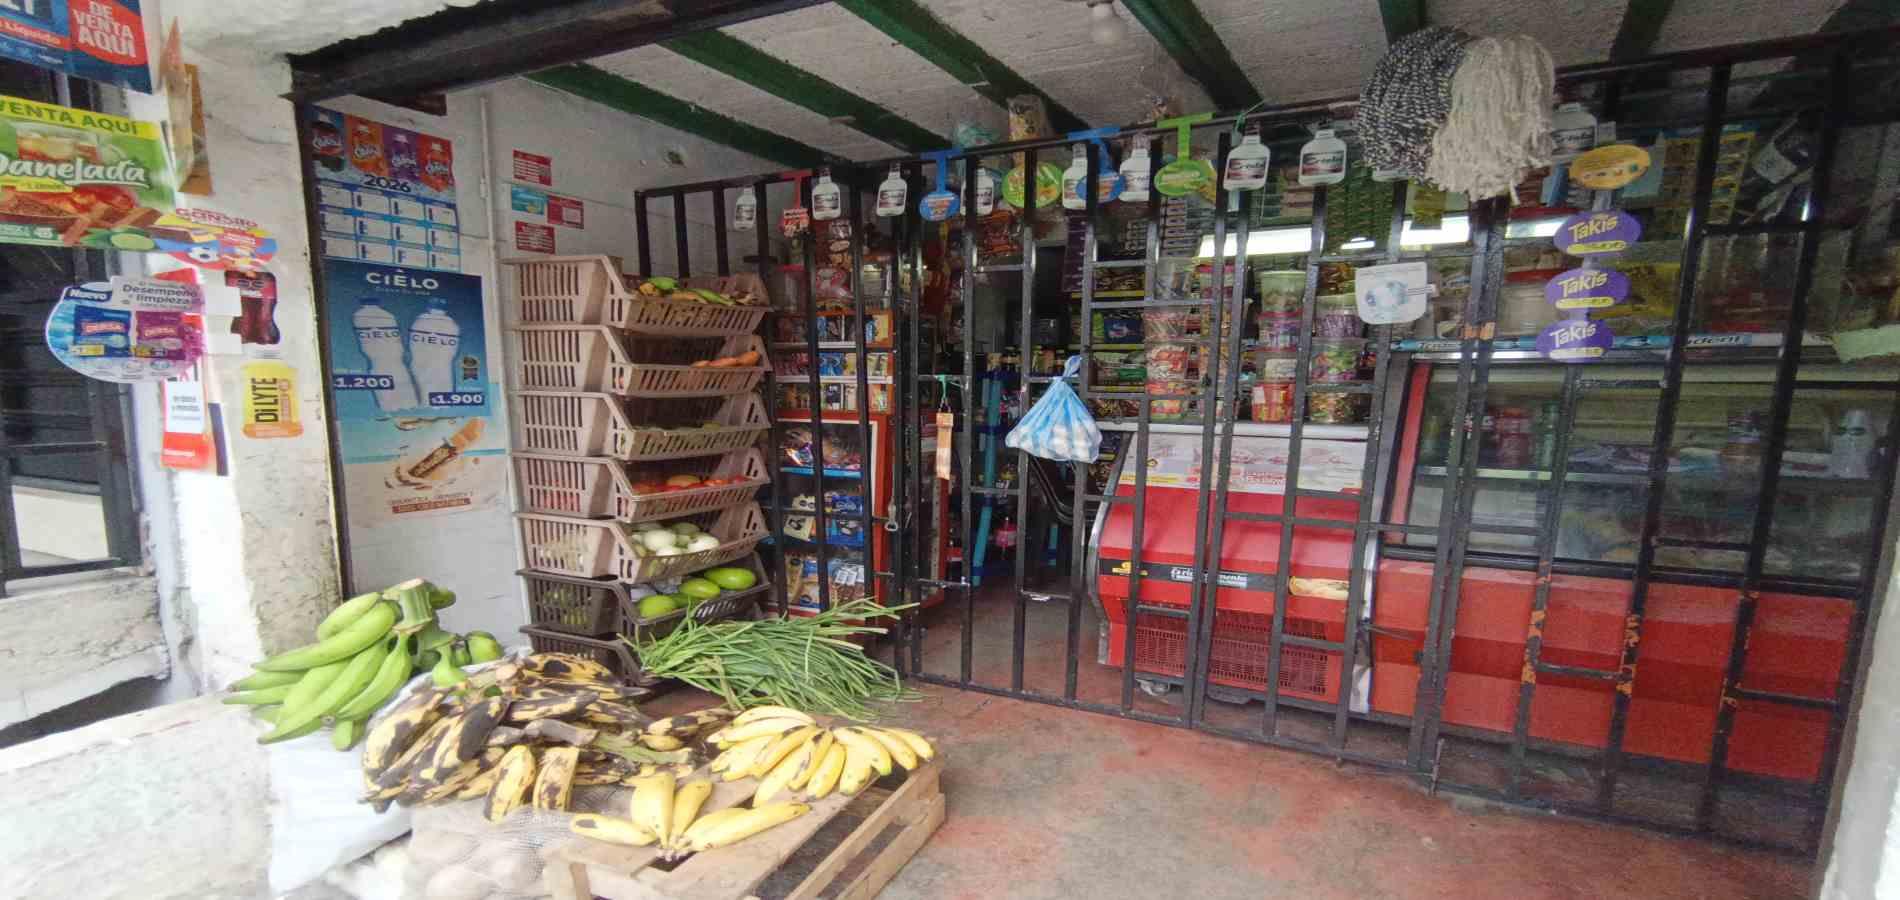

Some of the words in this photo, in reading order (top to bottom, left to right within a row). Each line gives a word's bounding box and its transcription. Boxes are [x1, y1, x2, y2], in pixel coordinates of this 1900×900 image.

[89, 1, 113, 19] DE
[72, 9, 134, 40] VENTA
[364, 174, 411, 193] 2026
[1568, 214, 1618, 243] Takis
[123, 283, 198, 298] Desempeño
[1558, 272, 1608, 297] Takis
[70, 288, 107, 301] Nuevo
[136, 293, 191, 305] limpieza
[1550, 323, 1597, 348] Takis
